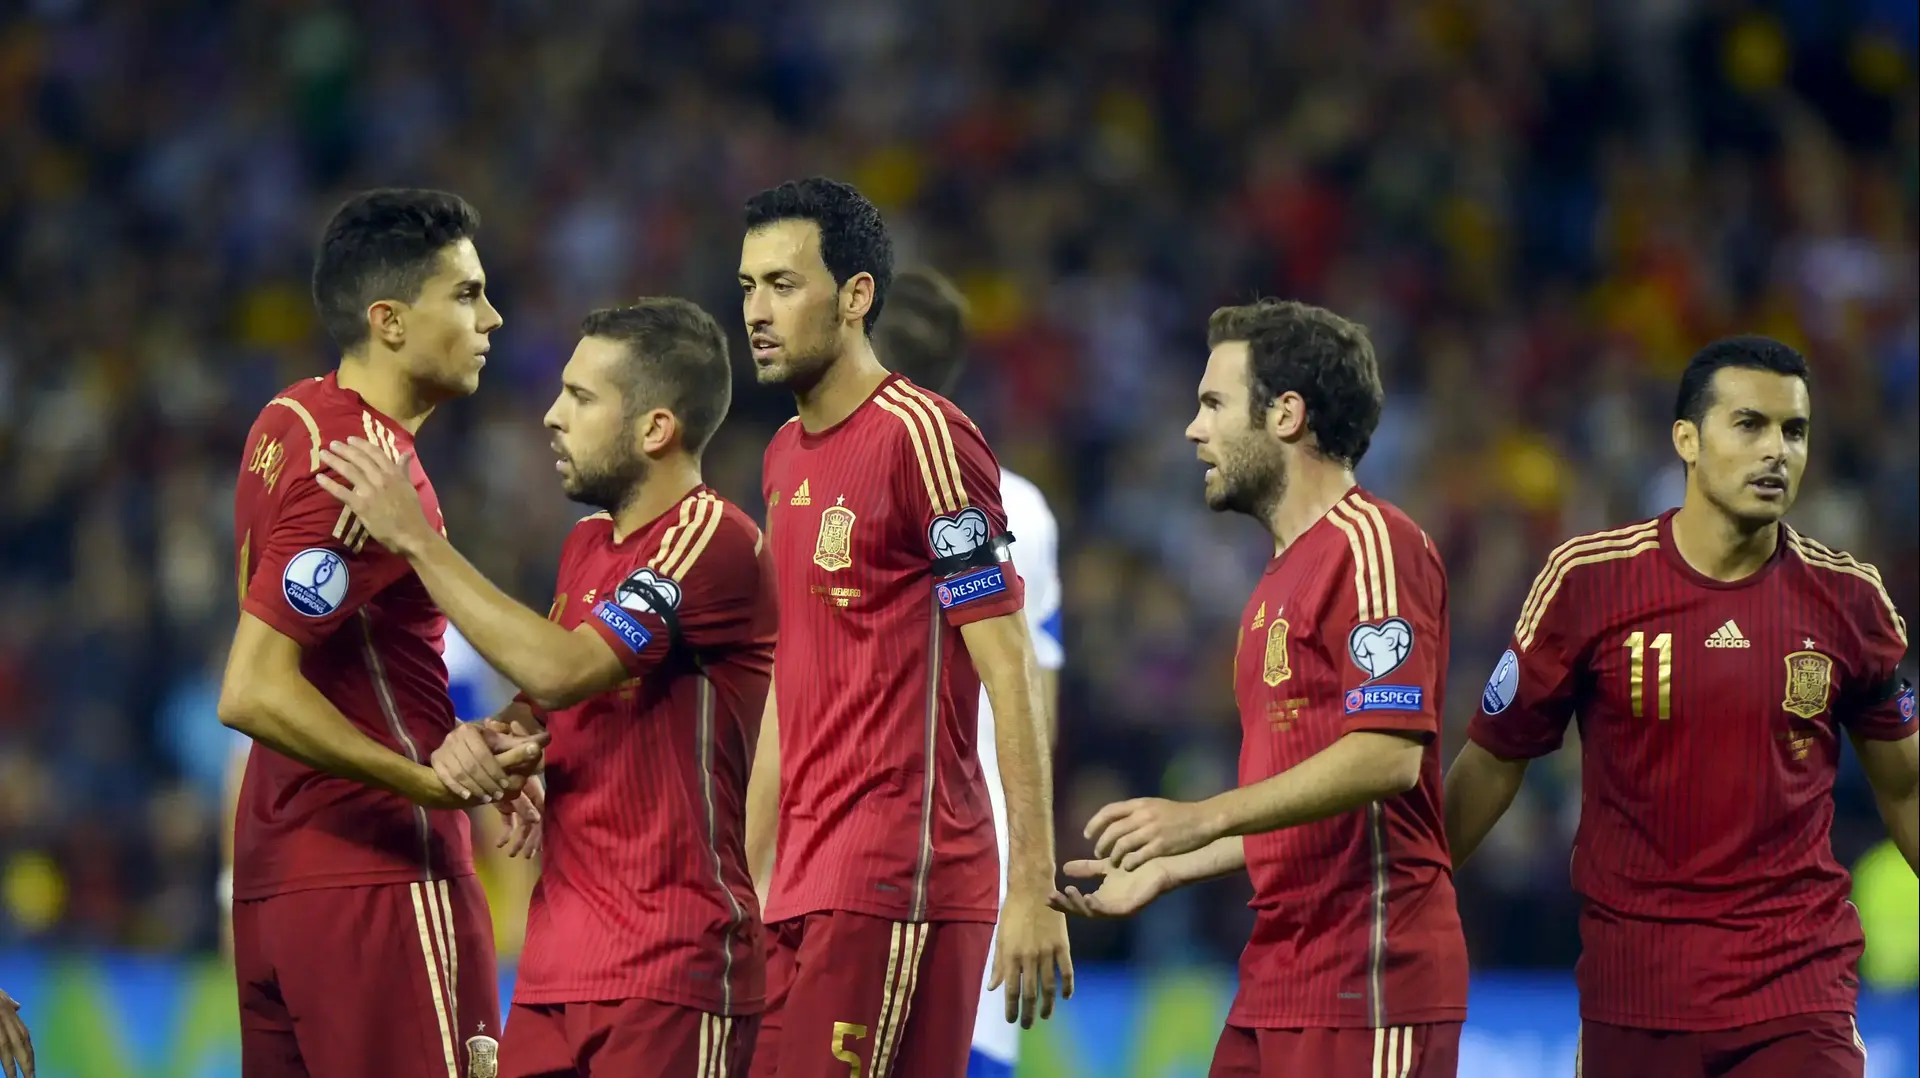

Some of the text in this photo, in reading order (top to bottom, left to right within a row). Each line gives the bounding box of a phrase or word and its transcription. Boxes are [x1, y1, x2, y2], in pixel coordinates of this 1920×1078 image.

[951, 573, 1002, 598] RESPECT
[287, 587, 326, 614] CHAMPIONS
[600, 607, 648, 648] RESPECT
[1704, 637, 1751, 649] adidas
[1622, 631, 1672, 720] 11
[1364, 691, 1422, 704] RESPECT
[831, 1021, 868, 1078] 5
